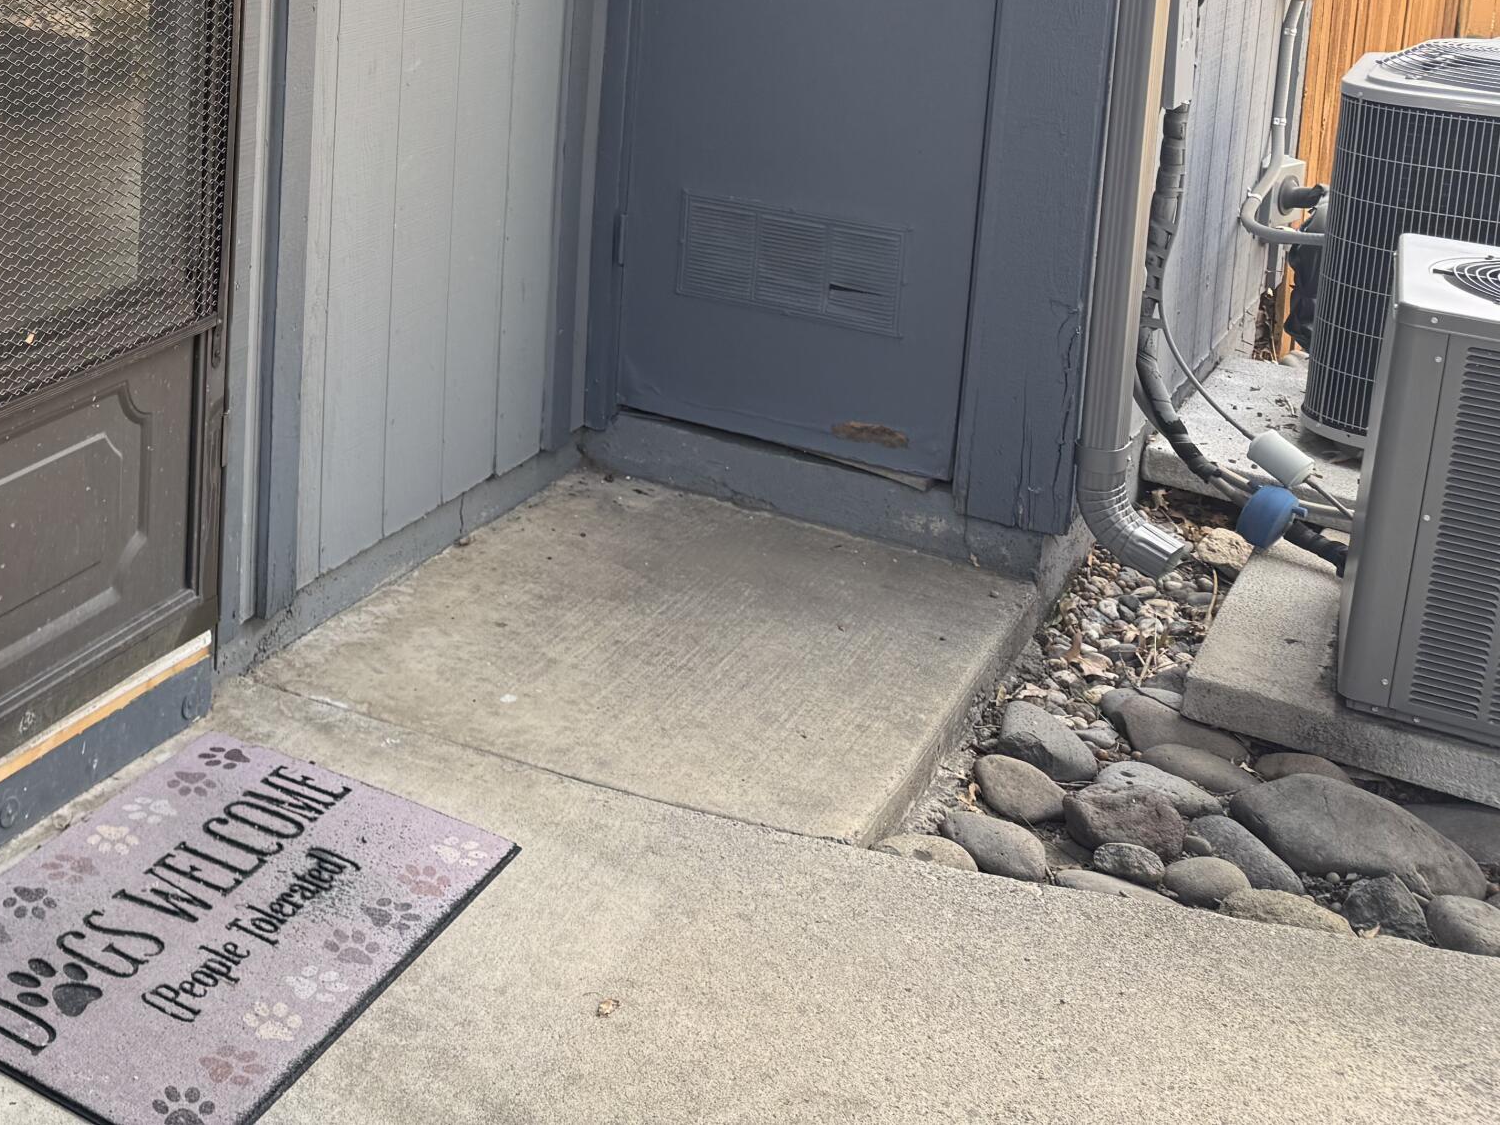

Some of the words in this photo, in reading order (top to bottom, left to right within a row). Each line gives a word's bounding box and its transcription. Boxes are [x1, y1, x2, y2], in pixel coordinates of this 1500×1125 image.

[111, 764, 353, 924] WELCOME
[141, 940, 250, 1023] (People
[224, 846, 362, 947] Tolerated)
